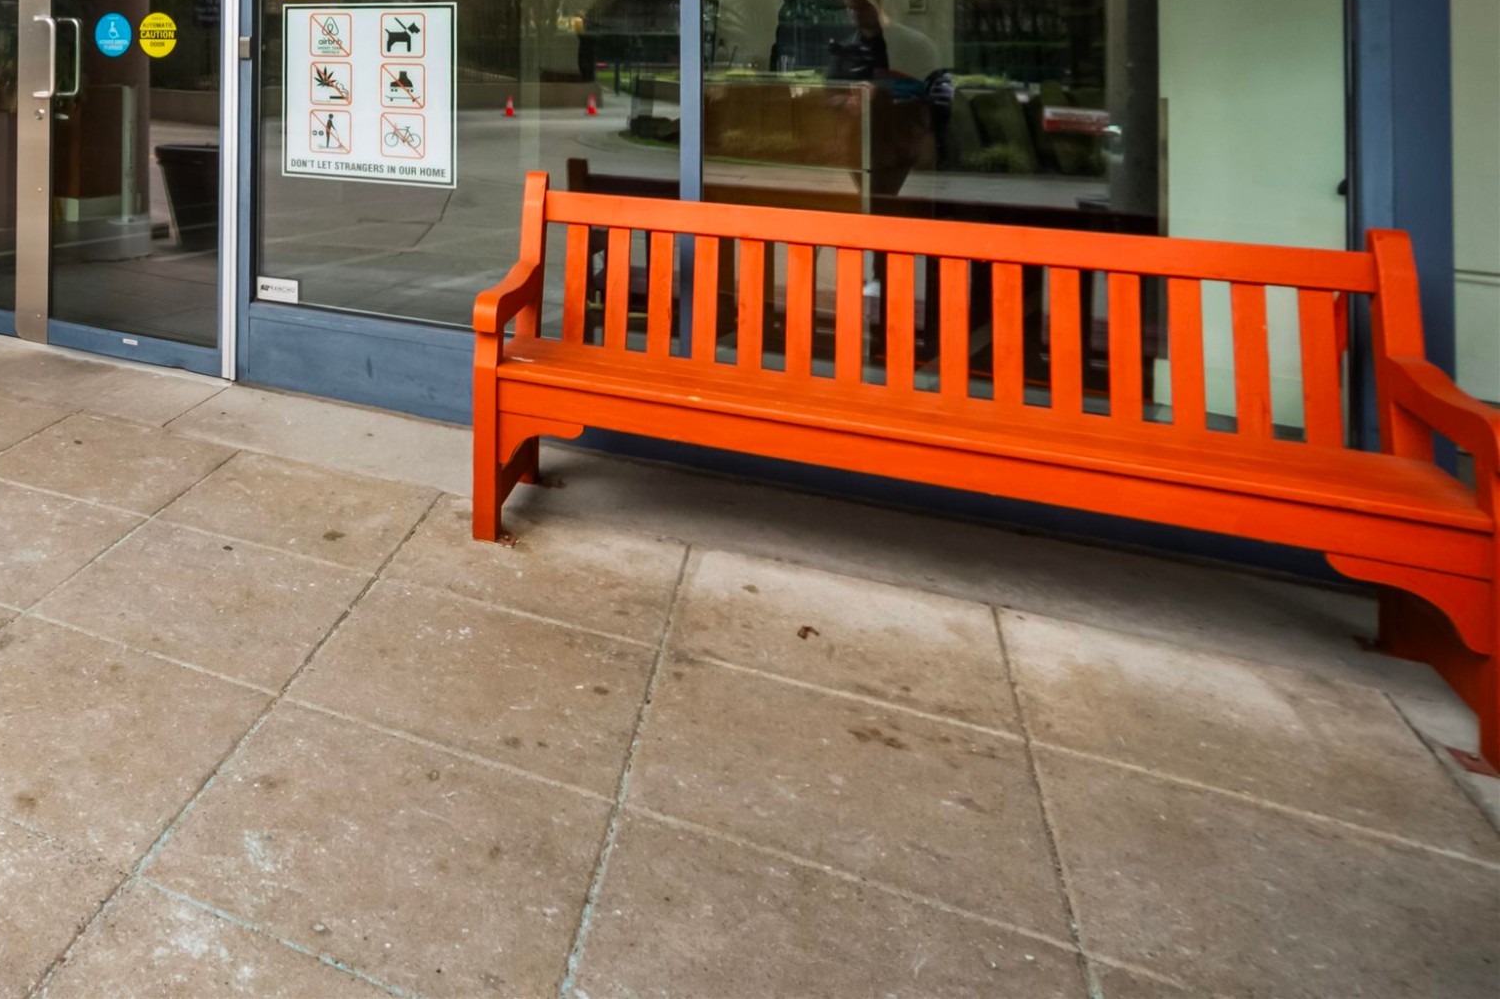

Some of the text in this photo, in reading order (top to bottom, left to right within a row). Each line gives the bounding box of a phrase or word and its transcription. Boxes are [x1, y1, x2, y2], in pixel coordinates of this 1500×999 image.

[140, 30, 175, 39] CAUTION
[291, 158, 446, 178] DON'T LET STRANGERS IN OUR HOME
